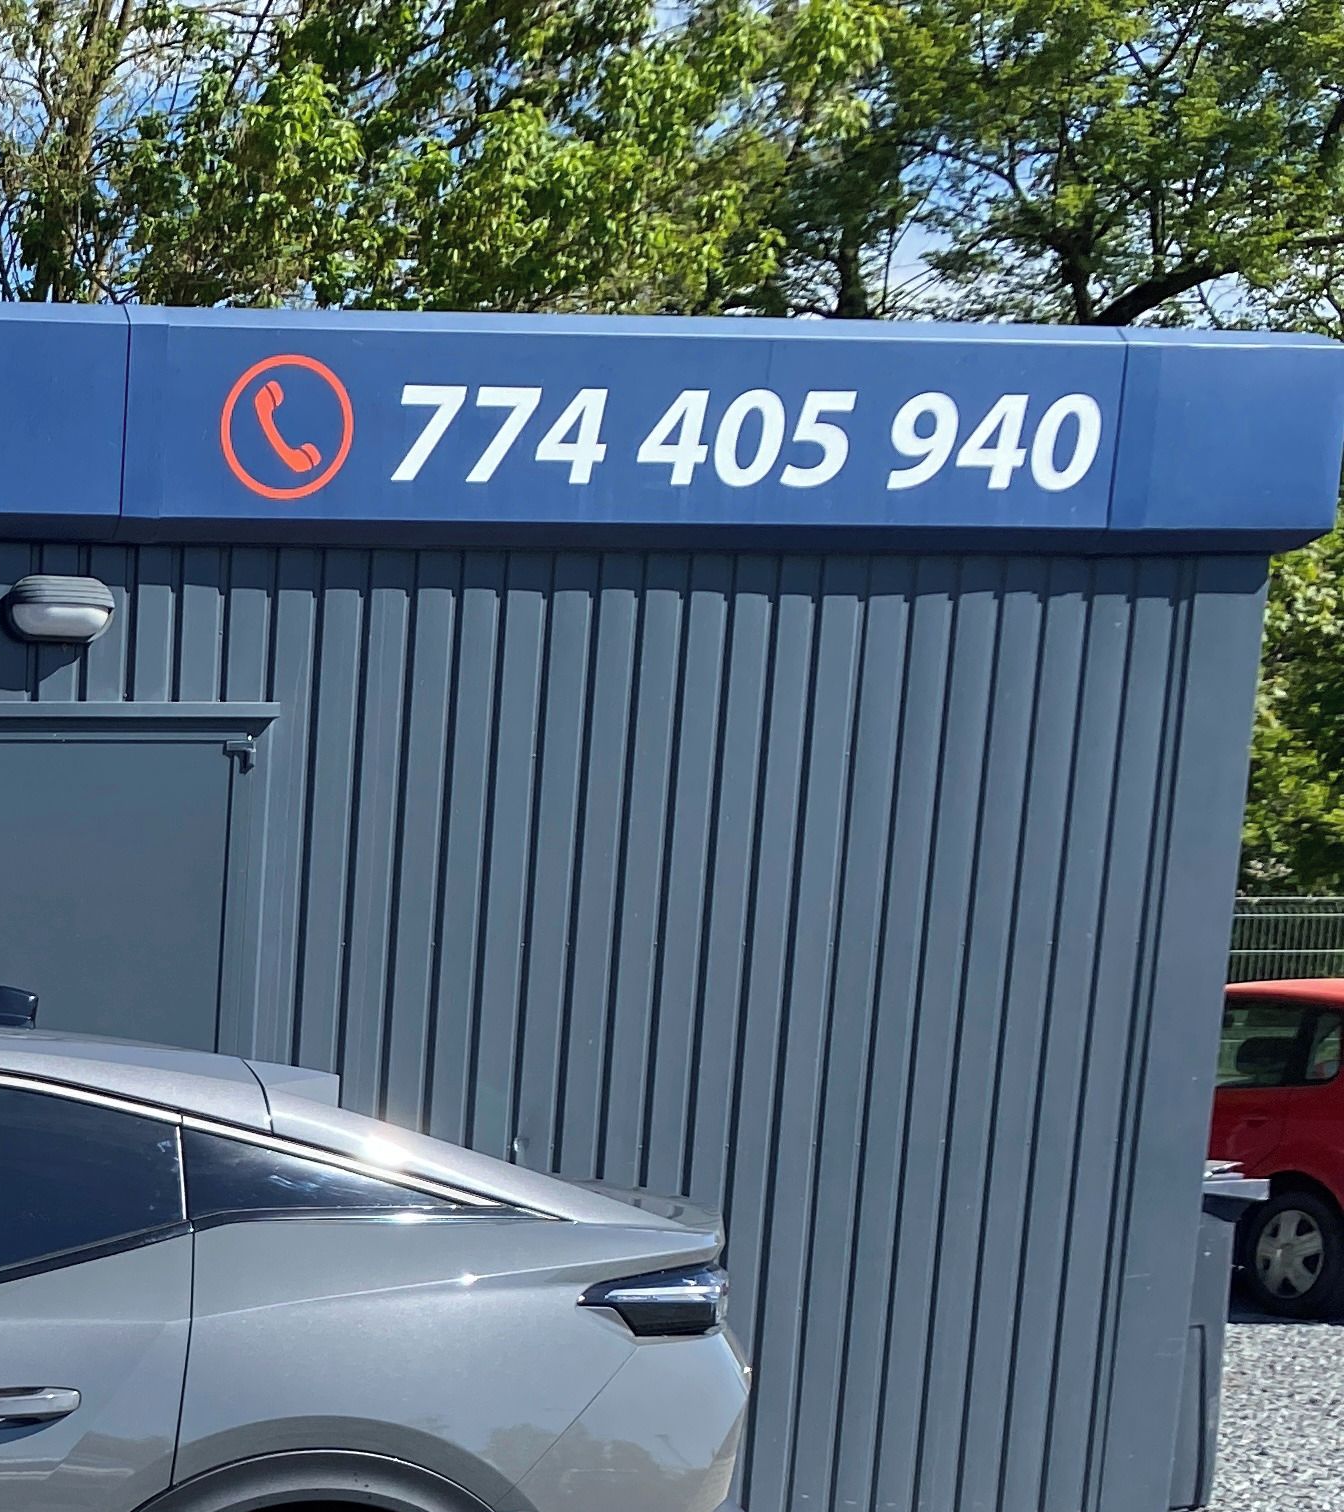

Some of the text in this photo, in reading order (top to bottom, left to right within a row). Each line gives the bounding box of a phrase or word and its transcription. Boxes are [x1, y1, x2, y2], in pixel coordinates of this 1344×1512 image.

[390, 384, 1103, 491] 774 405 940
